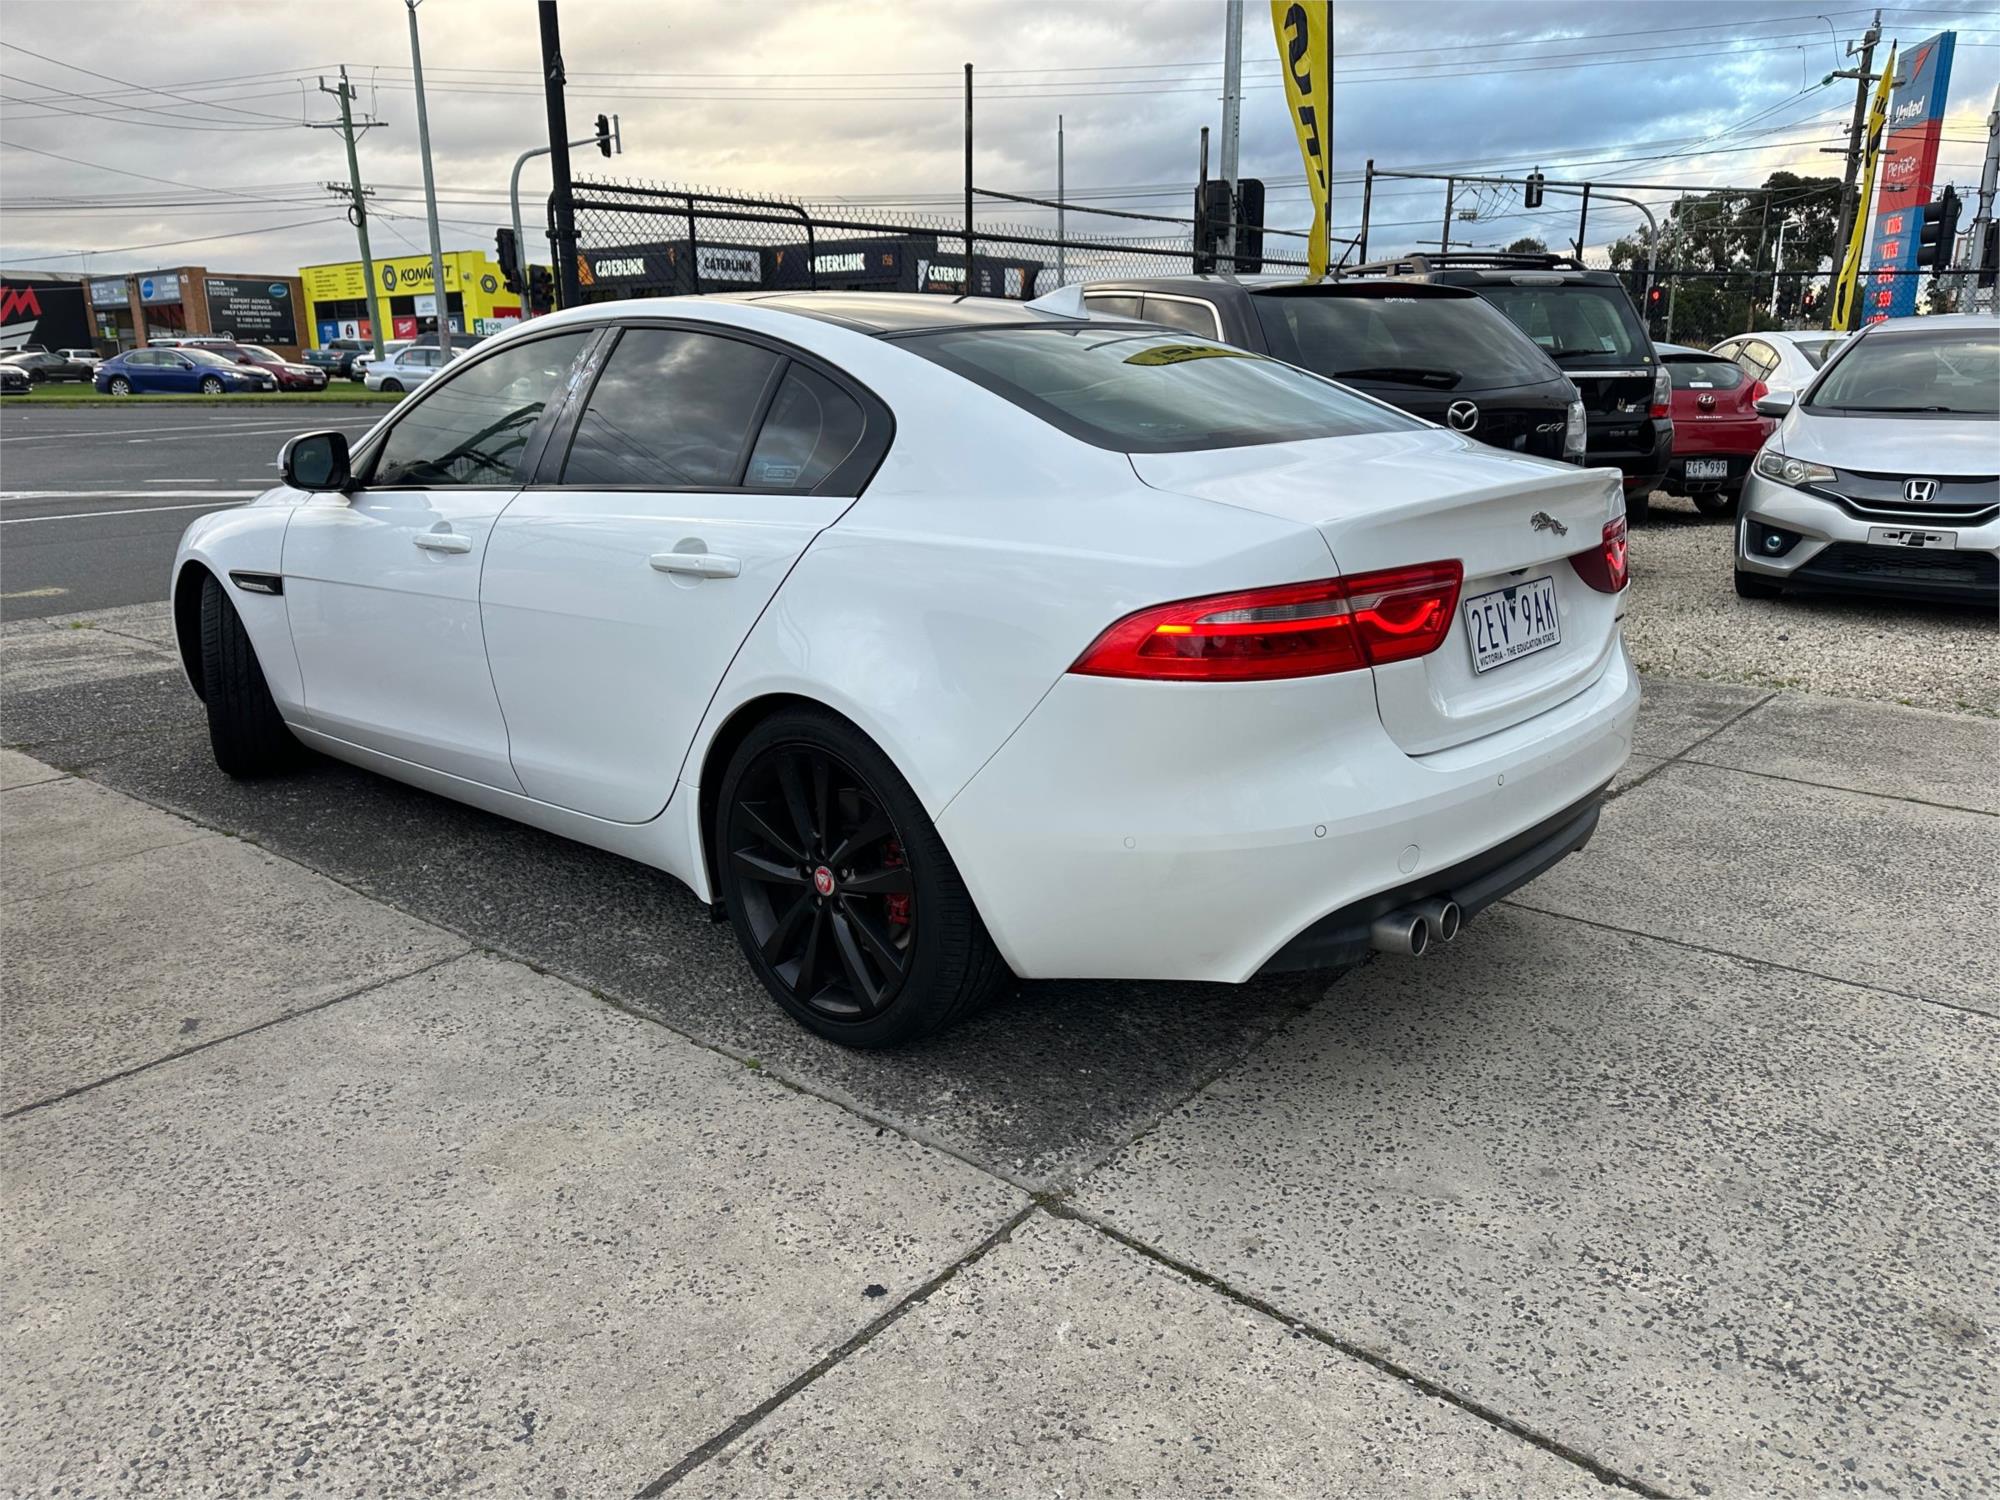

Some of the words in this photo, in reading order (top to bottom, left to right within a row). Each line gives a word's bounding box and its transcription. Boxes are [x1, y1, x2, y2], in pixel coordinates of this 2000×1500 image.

[1895, 95, 1925, 124] United
[400, 264, 453, 283] KONNT
[595, 258, 646, 278] CATERLINK
[704, 257, 752, 272] CATERLINK
[485, 322, 502, 331] FOR
[1686, 462, 1703, 475] ZGF
[1710, 461, 1727, 474] 999
[1471, 601, 1510, 654] 2EV
[1521, 587, 1556, 637] 9AK
[1479, 651, 1504, 667] VICTORIA
[1506, 646, 1518, 657] THE
[1517, 638, 1542, 654] EDUCATION
[1542, 632, 1555, 644] STATE
